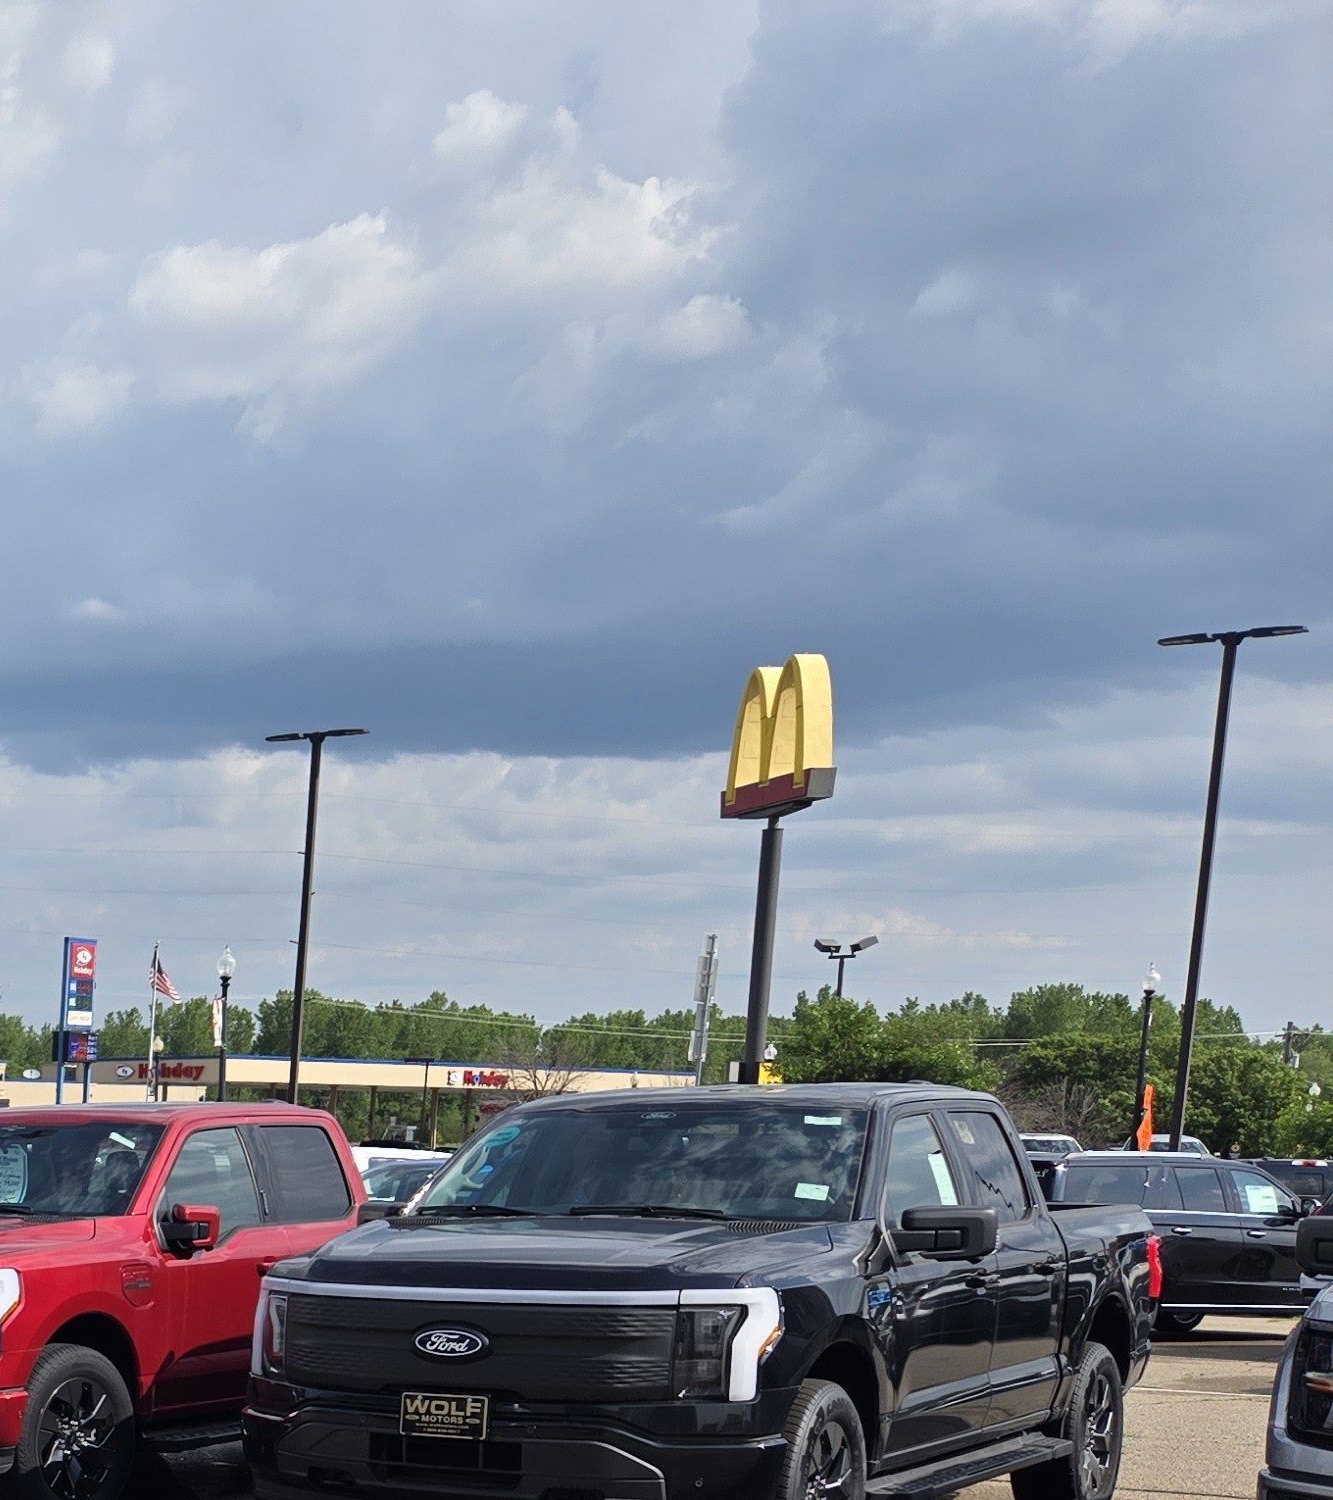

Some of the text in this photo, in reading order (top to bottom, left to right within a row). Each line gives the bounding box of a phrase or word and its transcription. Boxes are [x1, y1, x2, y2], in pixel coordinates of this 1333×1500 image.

[138, 1062, 205, 1081] Hliday
[426, 1333, 470, 1352] Ford
[405, 1398, 482, 1416] WOLF
[421, 1414, 464, 1424] MOTORS
